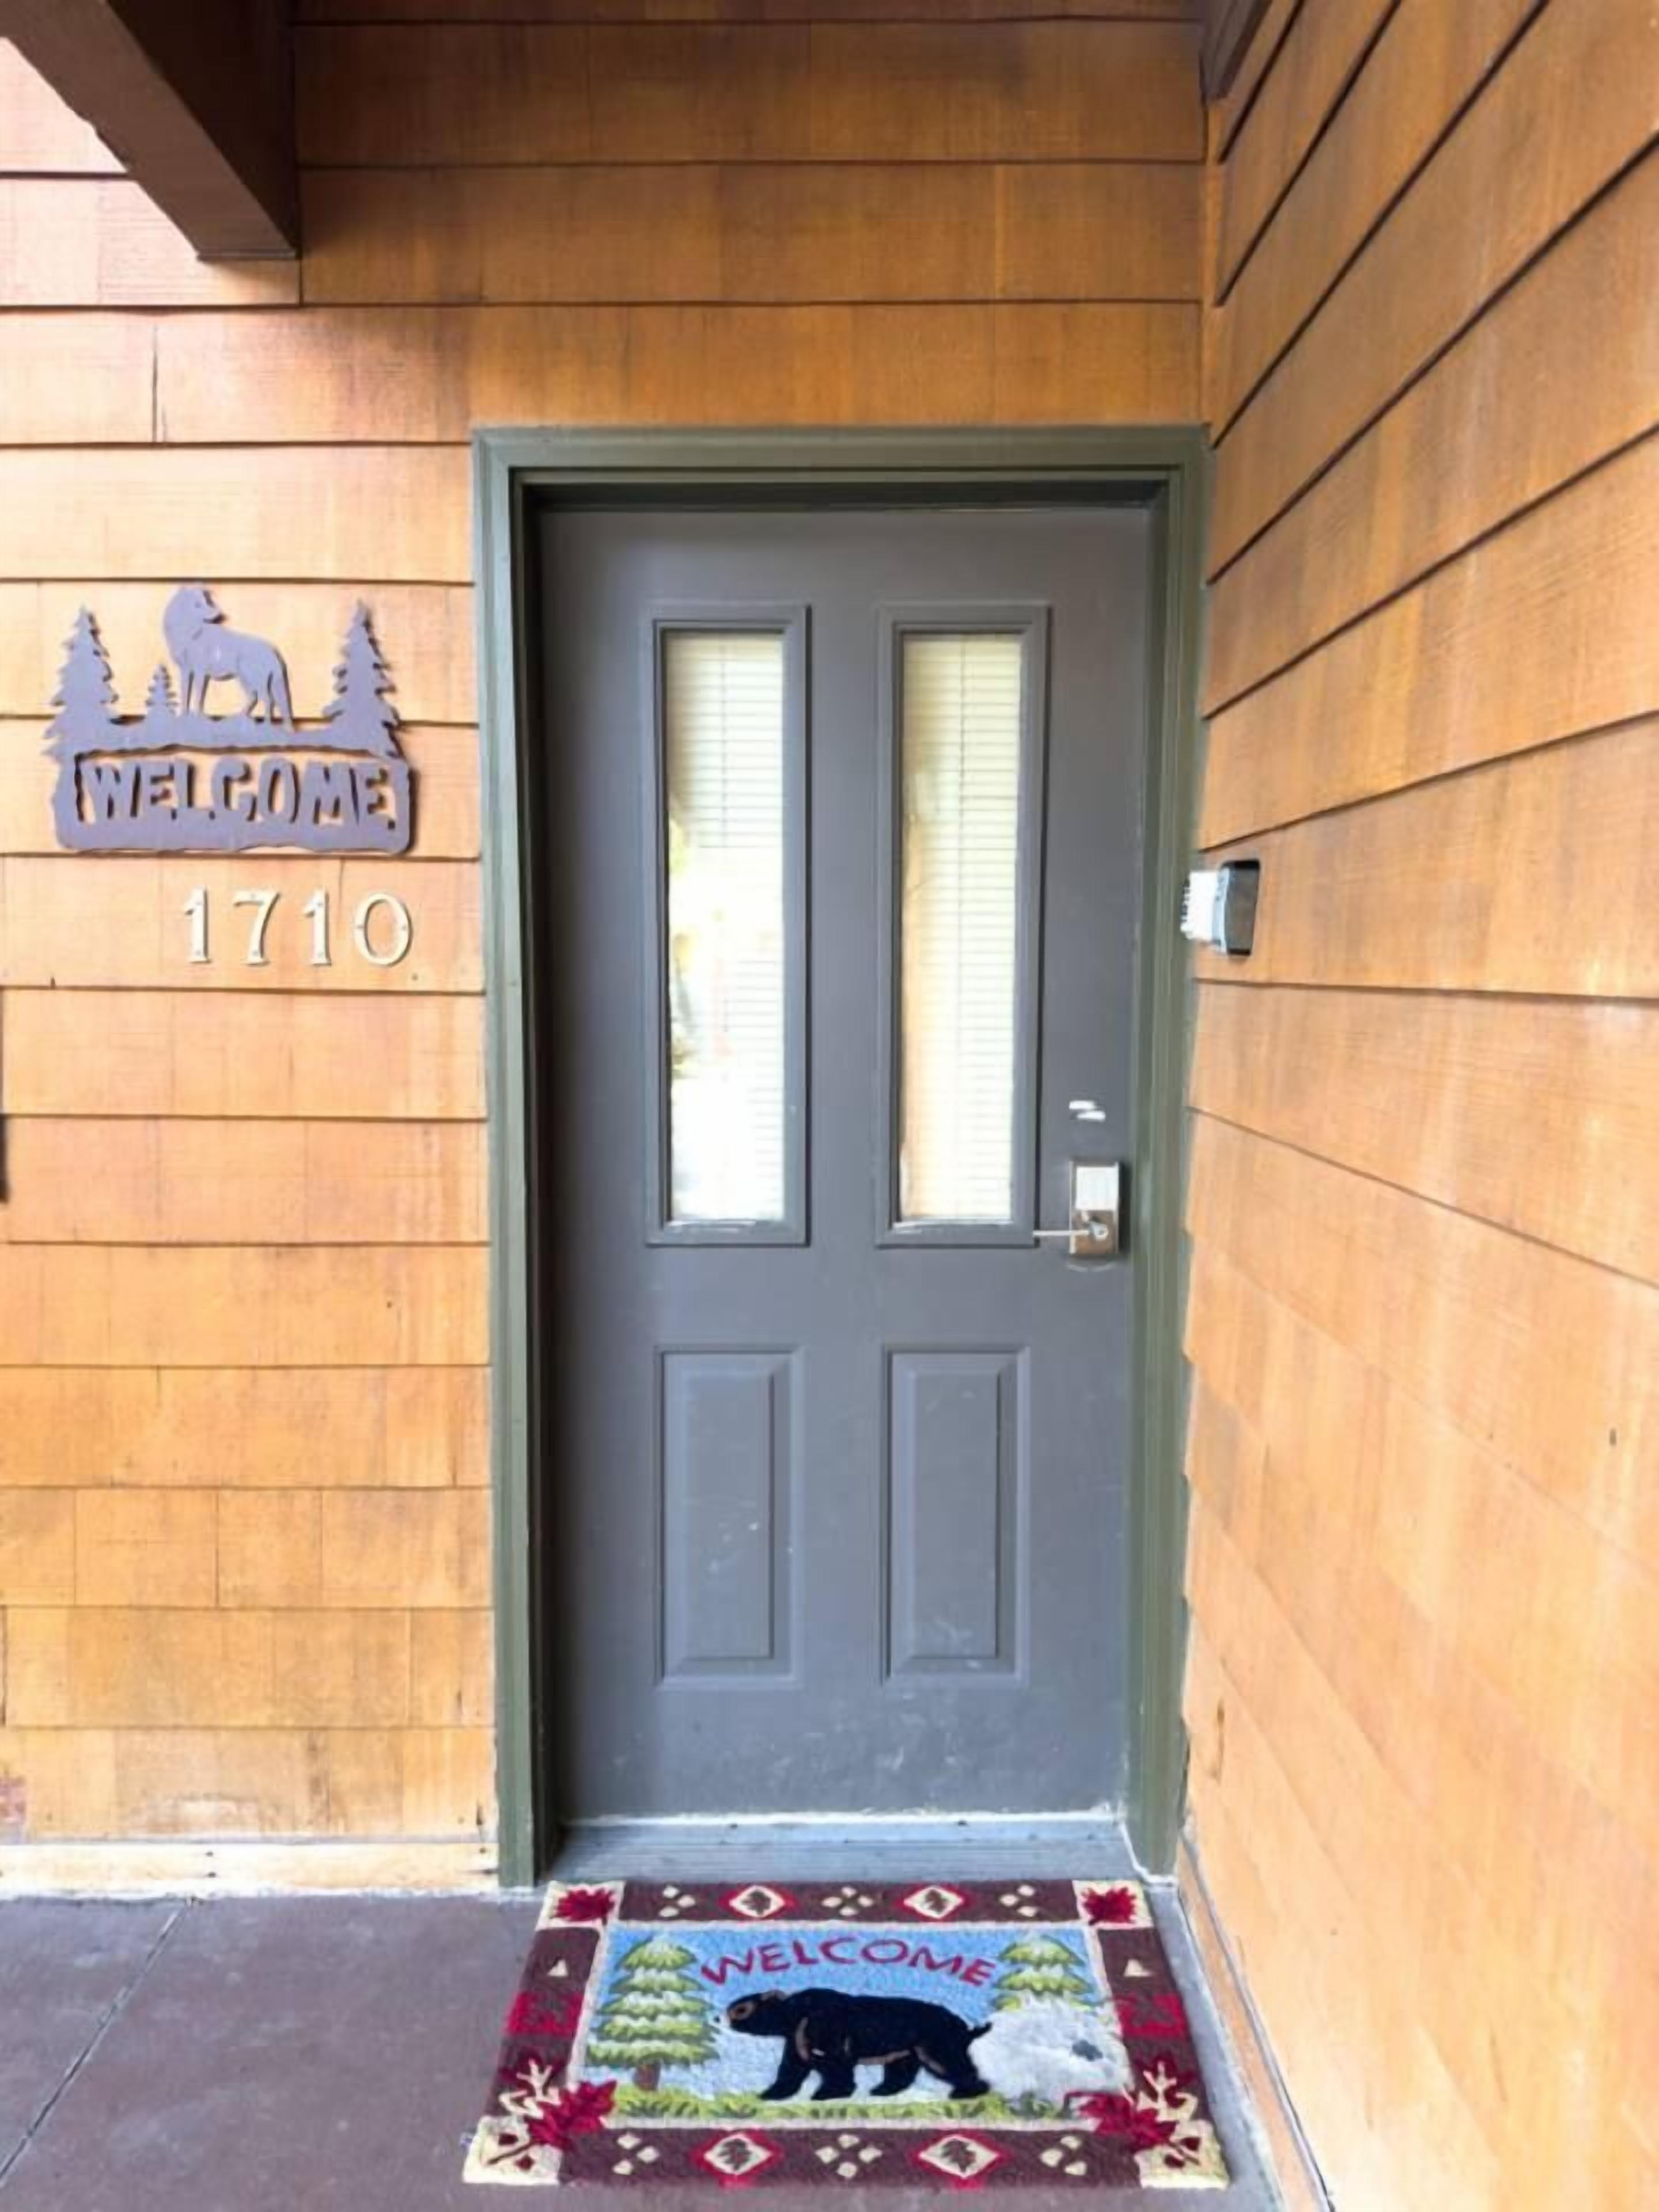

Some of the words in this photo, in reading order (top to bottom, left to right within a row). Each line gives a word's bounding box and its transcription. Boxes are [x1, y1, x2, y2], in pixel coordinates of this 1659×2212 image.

[79, 757, 399, 828] WELCOME
[183, 886, 413, 967] 1710
[700, 1936, 996, 1986] WELCOME
